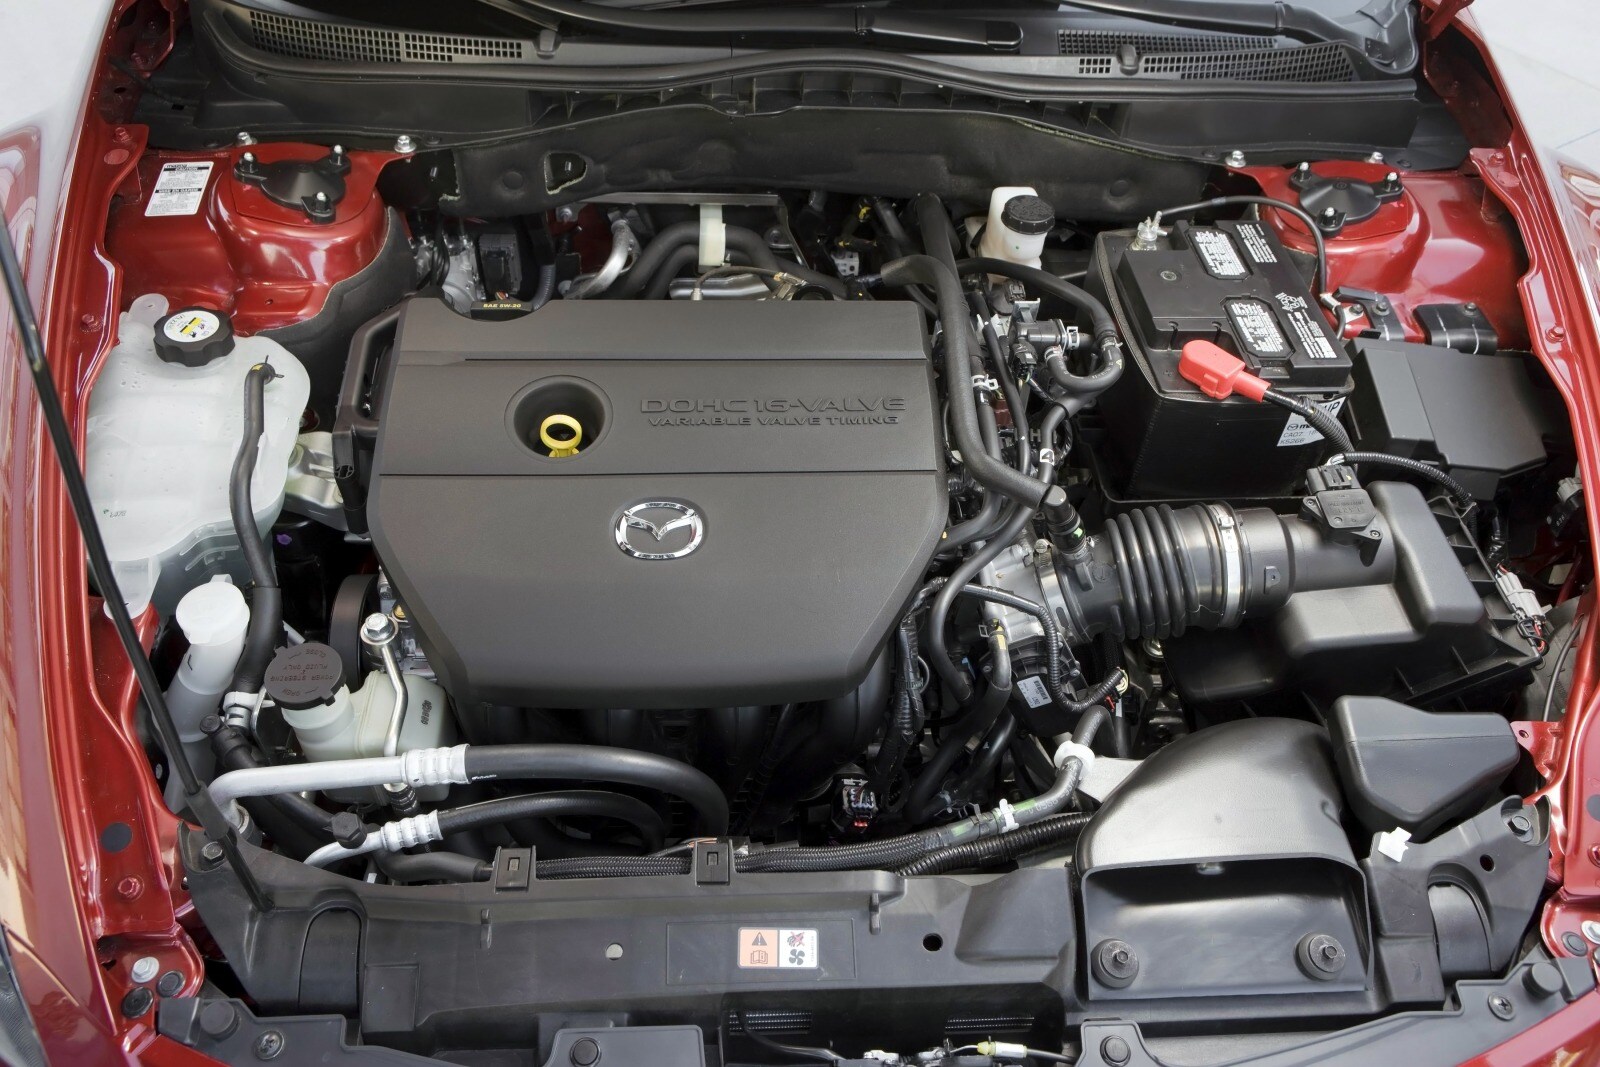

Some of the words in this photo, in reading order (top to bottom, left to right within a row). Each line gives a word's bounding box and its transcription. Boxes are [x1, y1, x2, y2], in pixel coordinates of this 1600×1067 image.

[641, 399, 748, 413] DOHC
[754, 397, 906, 413] 16-VALVE
[648, 416, 752, 426] VARIABLE
[758, 415, 822, 426] VALVE
[828, 415, 900, 425] TIMING
